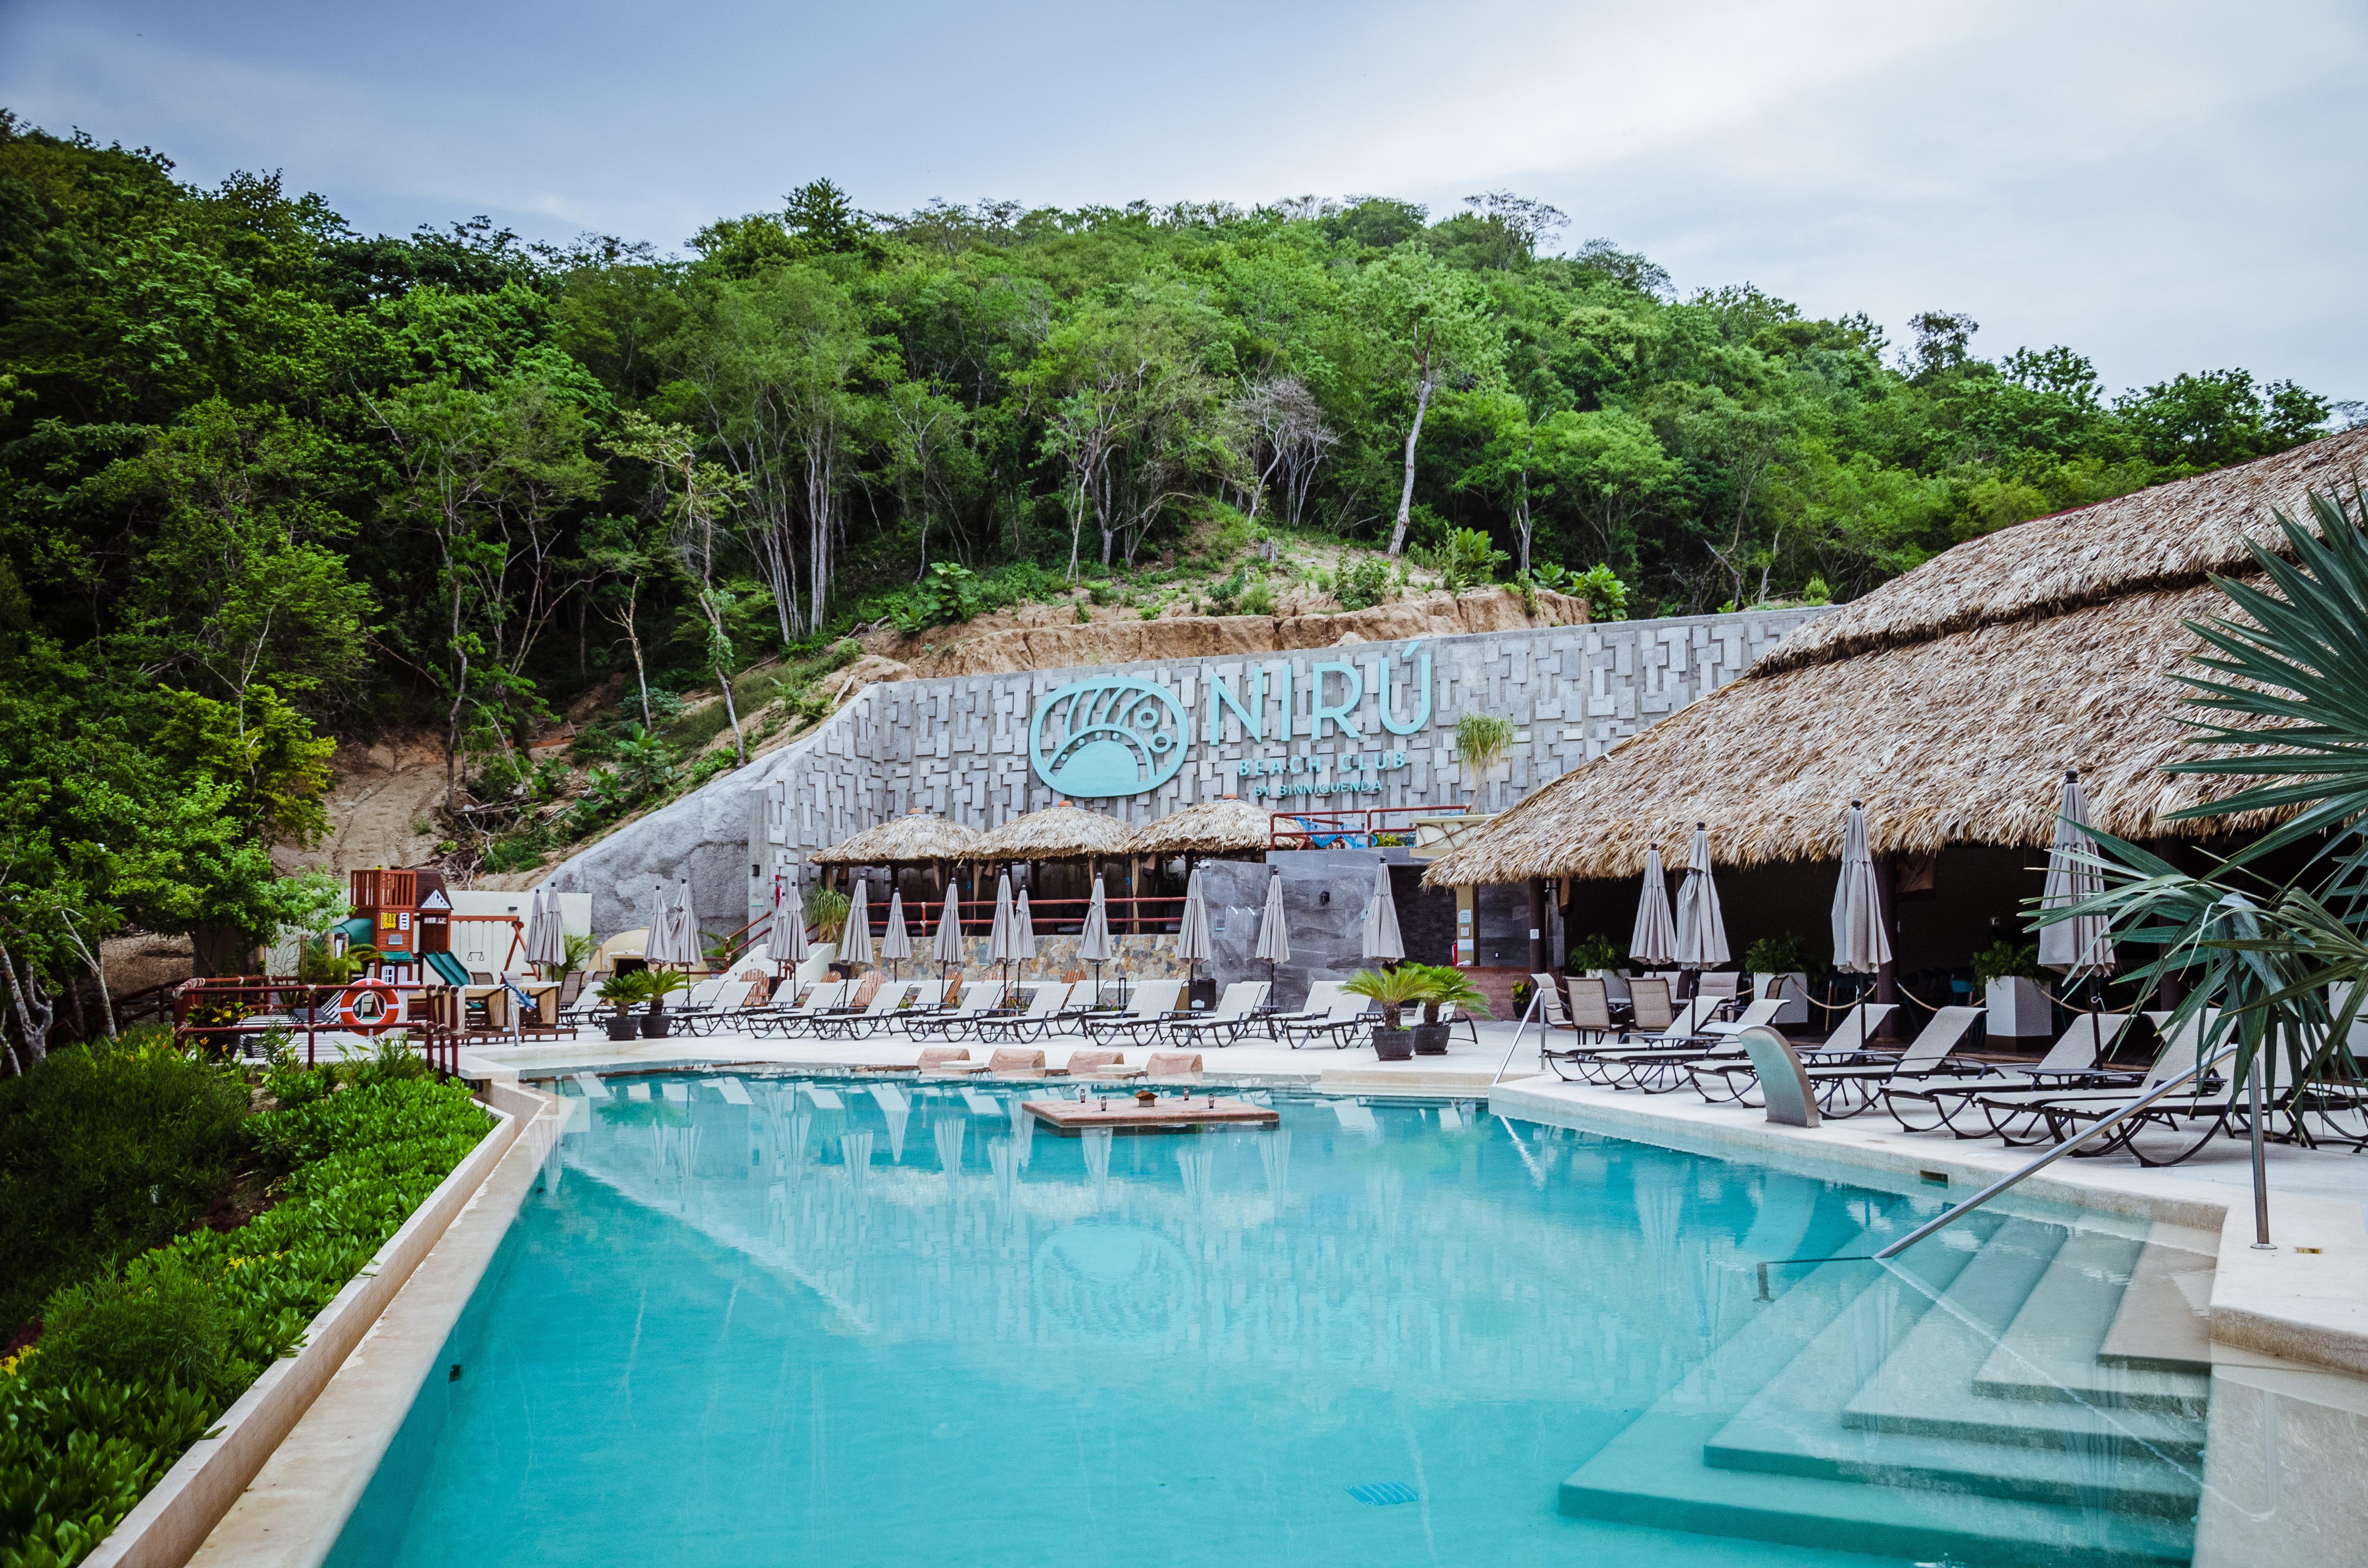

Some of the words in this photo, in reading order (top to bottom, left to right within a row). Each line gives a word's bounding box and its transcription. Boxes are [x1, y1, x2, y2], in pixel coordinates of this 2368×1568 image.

[1209, 641, 1431, 746] NIRÚ
[1238, 757, 1322, 776] BEACH
[1340, 752, 1406, 772] CLUB
[1255, 785, 1271, 796] BY
[1280, 780, 1383, 796] BINNIGUENDA
